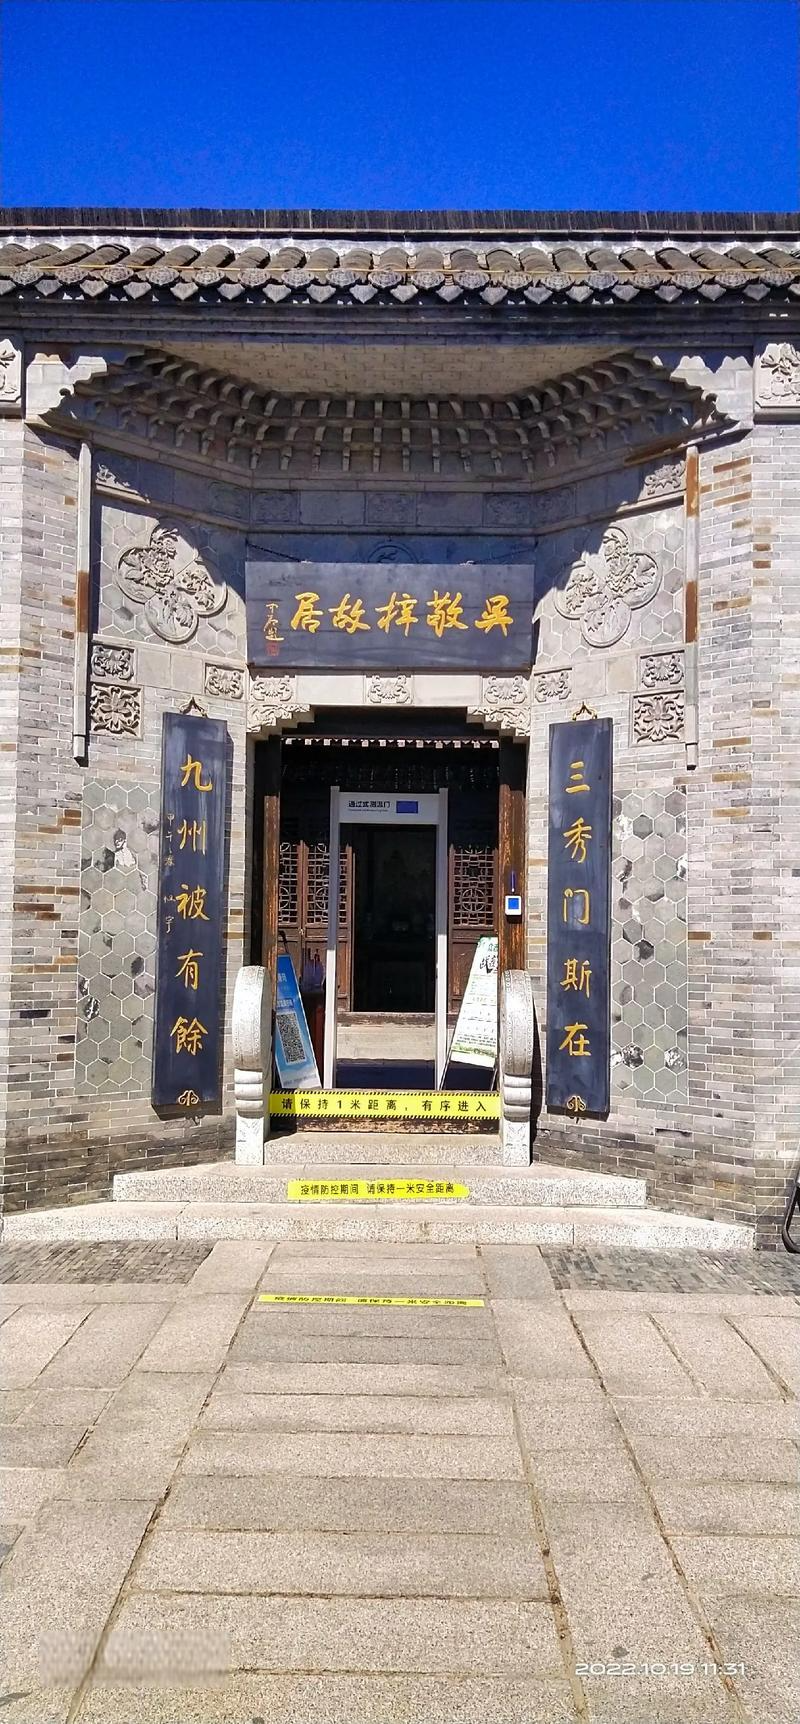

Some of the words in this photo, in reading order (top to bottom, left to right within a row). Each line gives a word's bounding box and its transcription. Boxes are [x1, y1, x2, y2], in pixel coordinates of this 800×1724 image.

[300, 1183, 359, 1196] 疫情防控期间
[366, 1181, 455, 1195] 请保持一米安全距离
